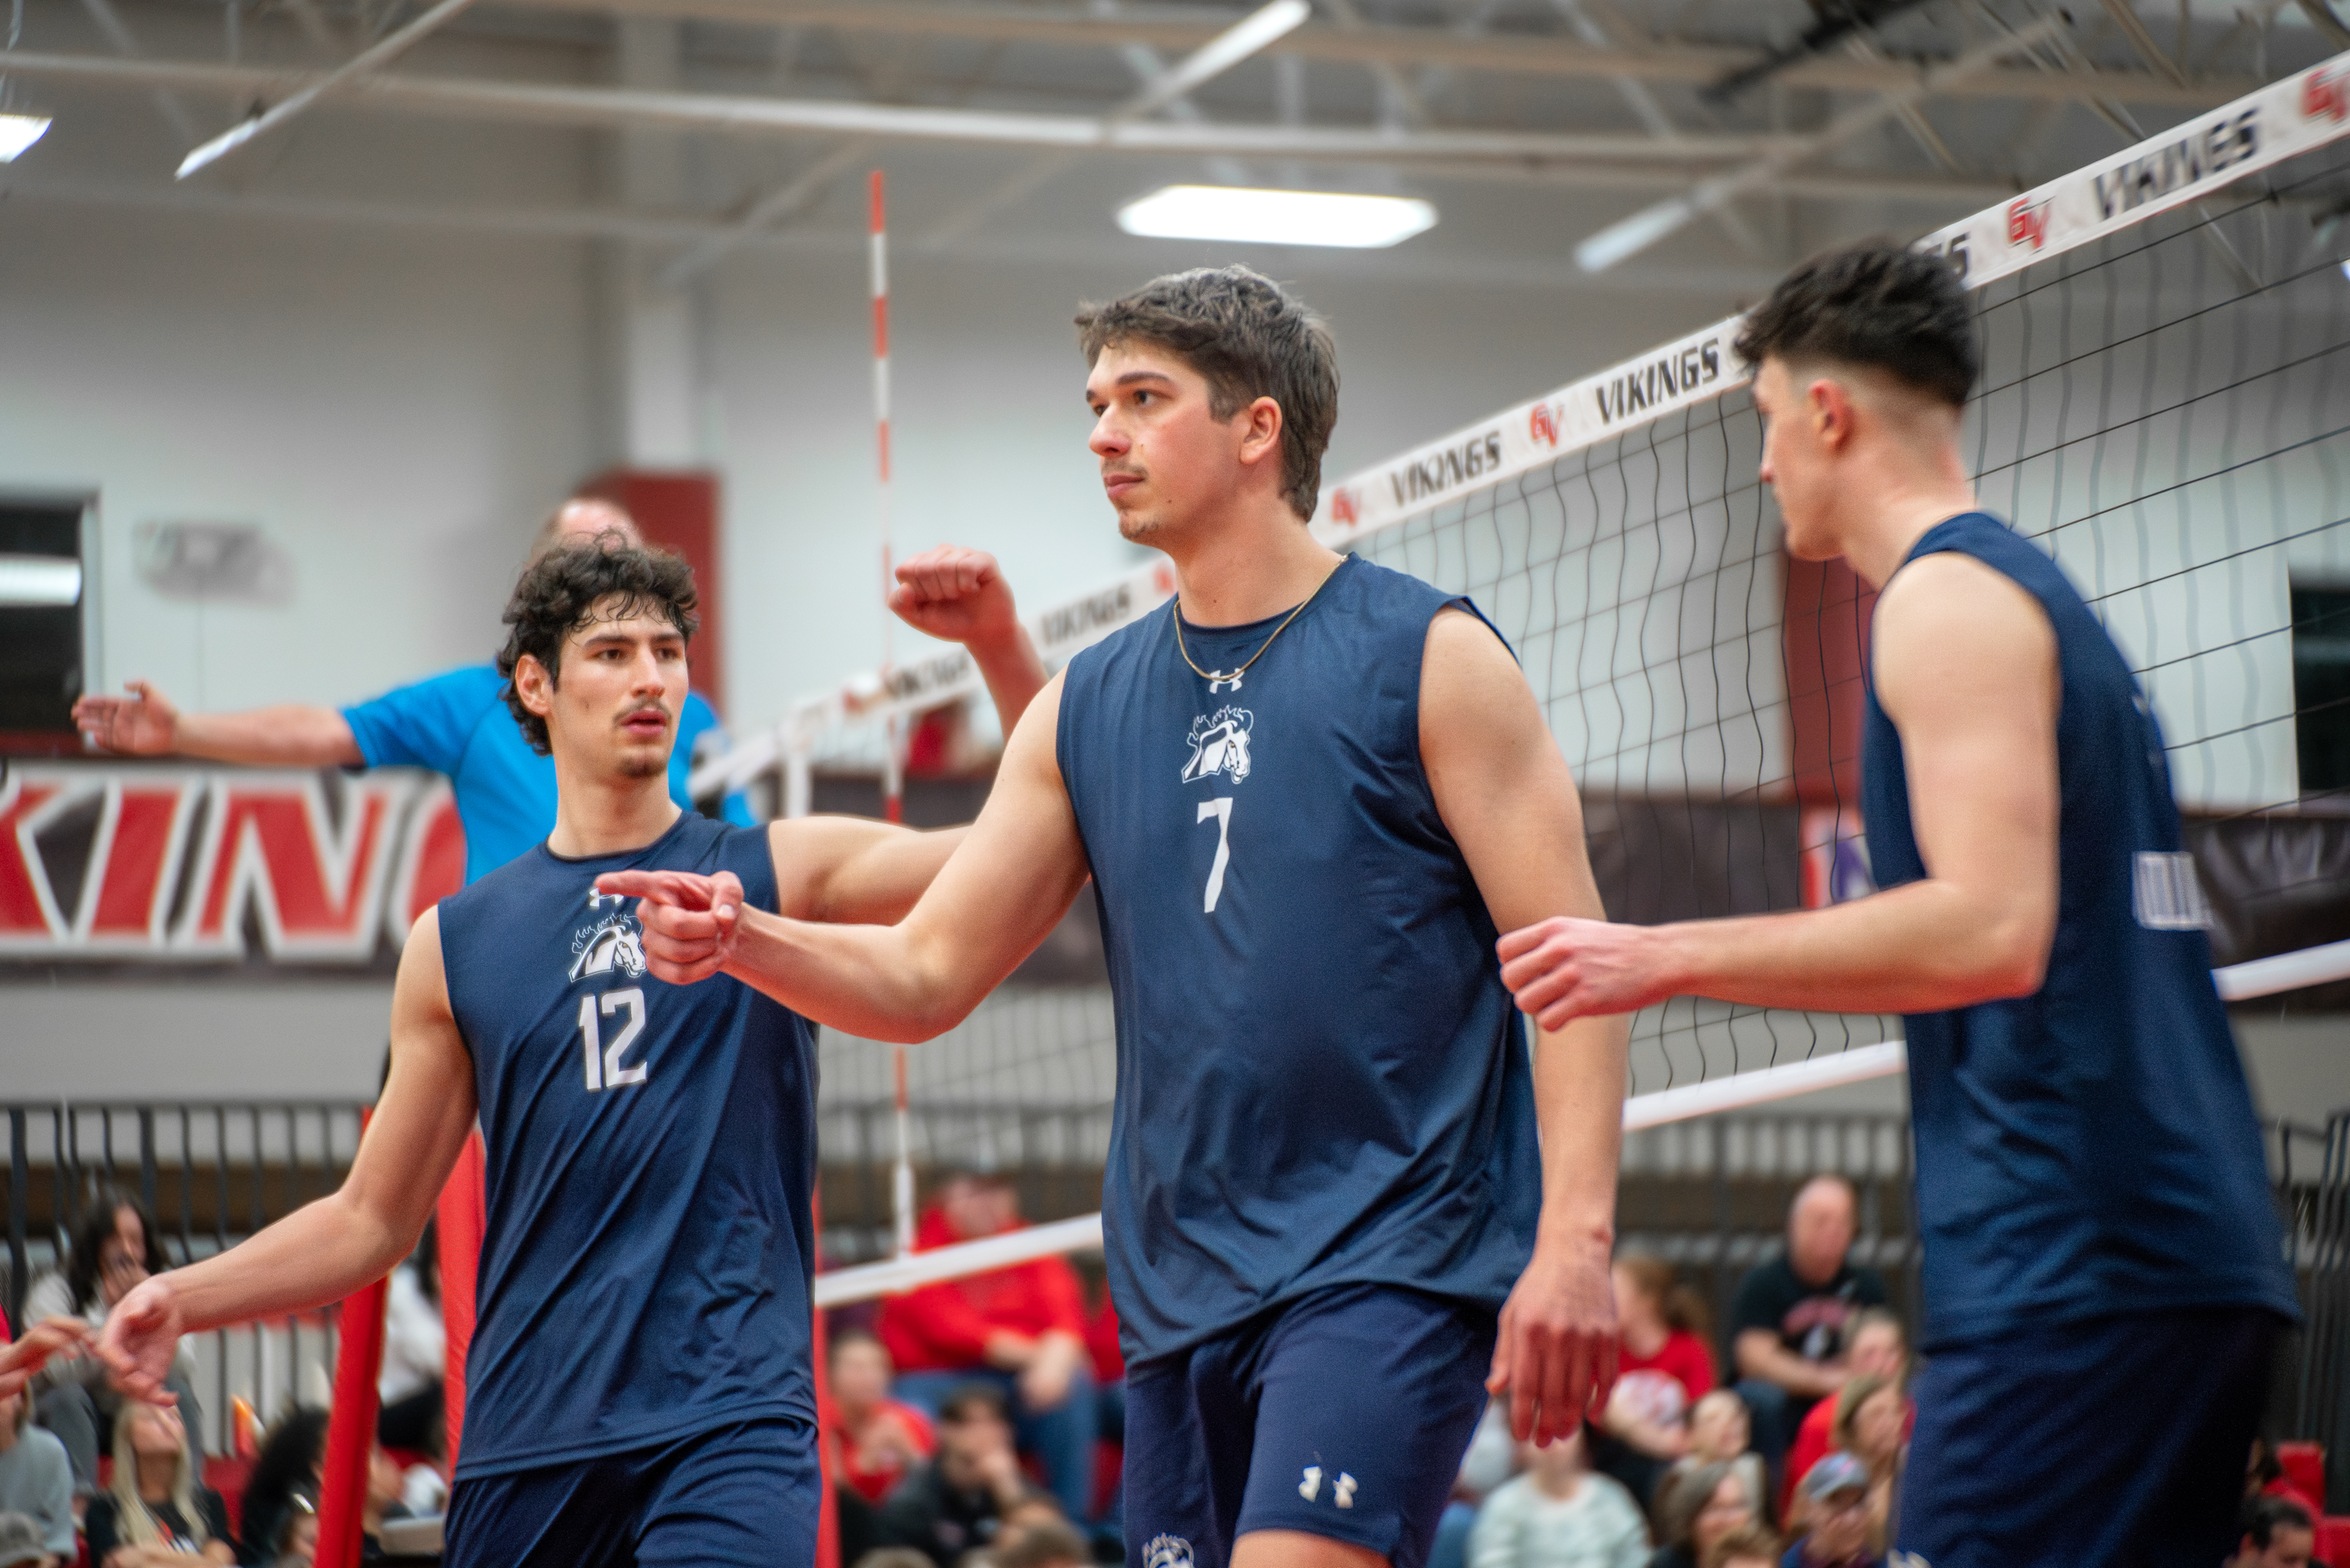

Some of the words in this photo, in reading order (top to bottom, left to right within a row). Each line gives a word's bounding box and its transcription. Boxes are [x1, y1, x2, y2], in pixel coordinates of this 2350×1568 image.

[1390, 431, 1501, 507] VIKINGS
[1596, 337, 1720, 425] VIKINGS
[2090, 105, 2260, 220] VIKINGS
[1197, 797, 1234, 913] 7
[579, 988, 647, 1091] 12
